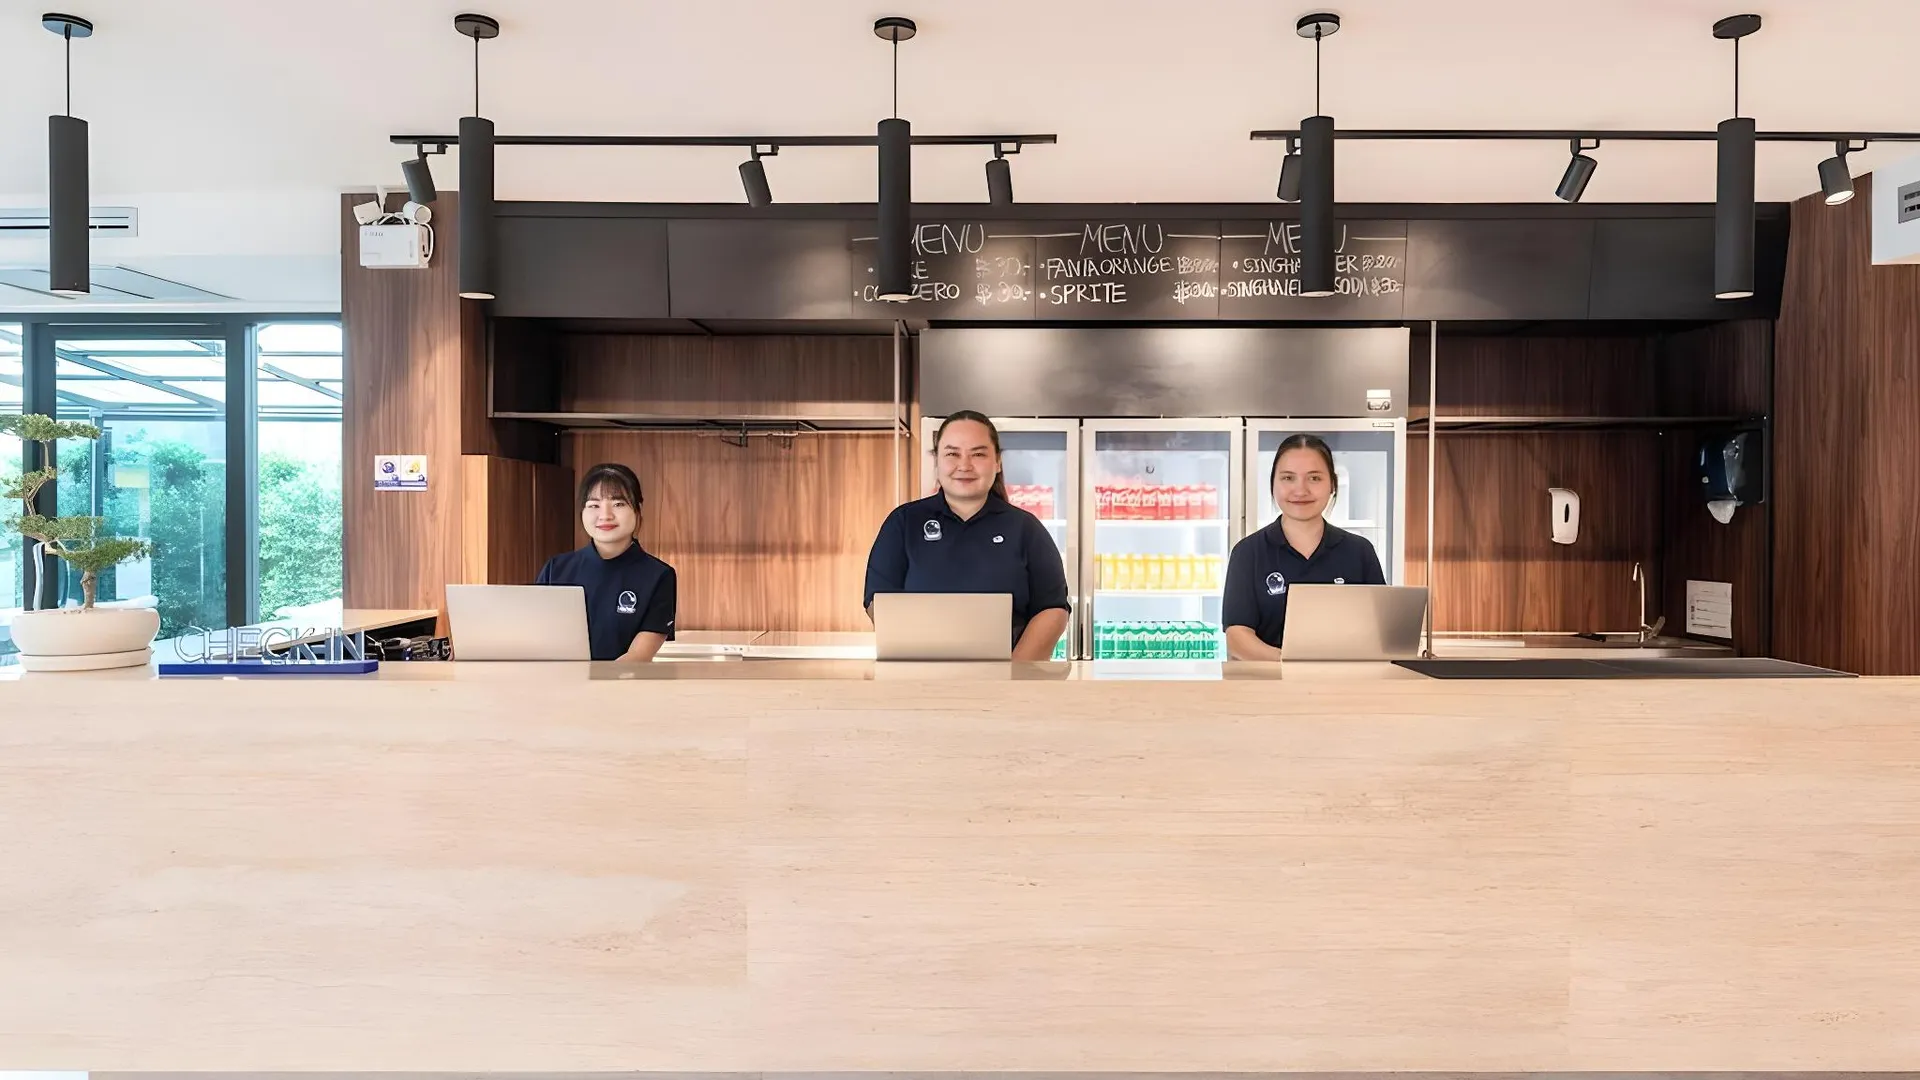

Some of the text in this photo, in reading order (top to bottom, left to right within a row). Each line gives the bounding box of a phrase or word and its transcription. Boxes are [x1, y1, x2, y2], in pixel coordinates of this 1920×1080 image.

[1080, 223, 1163, 255] MENU
[1264, 221, 1347, 255] MEU
[1051, 281, 1127, 304] SPRITE
